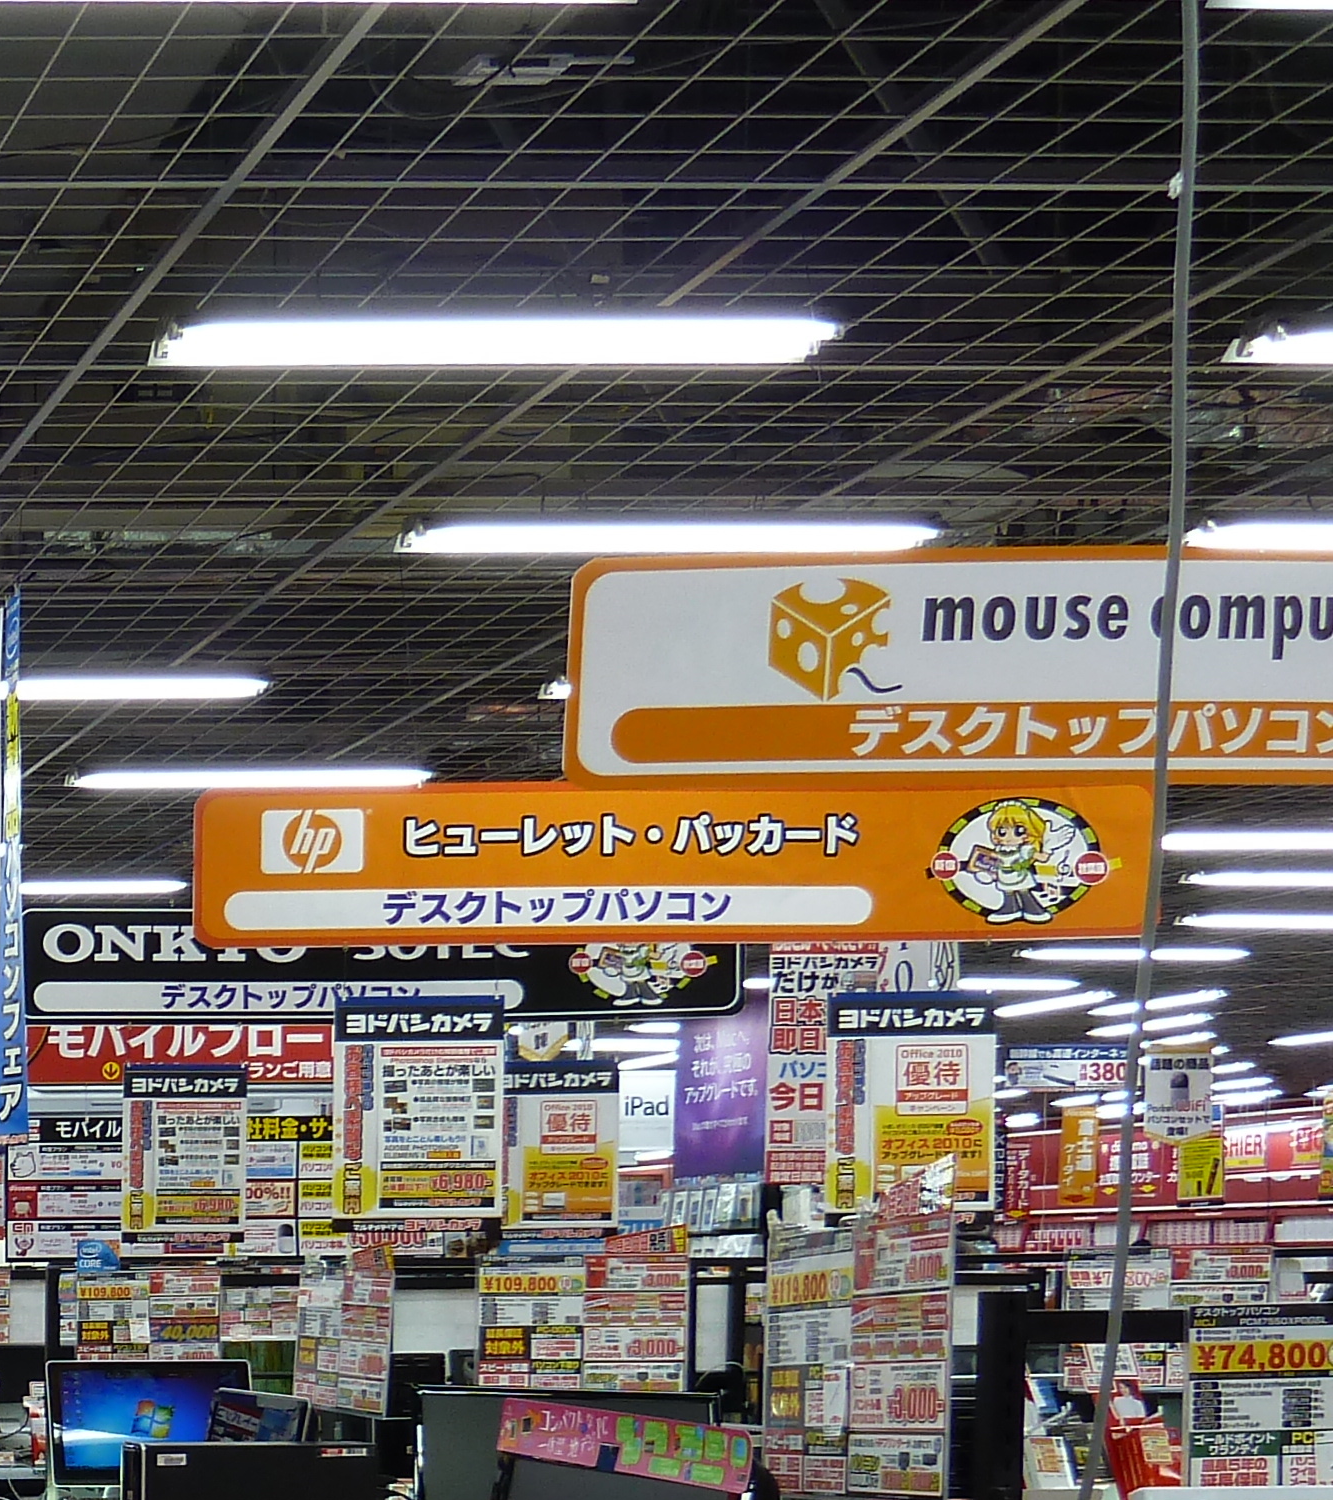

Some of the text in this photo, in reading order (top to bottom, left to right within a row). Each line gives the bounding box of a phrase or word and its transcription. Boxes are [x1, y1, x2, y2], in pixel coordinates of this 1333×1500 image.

[922, 594, 1130, 643] mouse
[289, 809, 336, 875] hp
[403, 815, 860, 859] ヒューレット・パッカード
[382, 889, 733, 928] デスクトップパソコン
[771, 954, 878, 970] ヨドバシカメラ
[772, 972, 839, 994] だけが
[345, 1012, 494, 1034] ヨドバシカメラ
[837, 1006, 986, 1028] ヨドバシカメラ
[900, 1048, 963, 1058] Office 2010
[382, 1064, 496, 1078] 撮ったあとが楽しい
[903, 1061, 961, 1086] 優待
[131, 1077, 240, 1094] ヨドバシカメラ
[624, 1095, 670, 1117] iPad
[55, 1120, 122, 1138] モバイル
[545, 1113, 592, 1133] 優待
[881, 1138, 929, 1150] オフィス
[1018, 1149, 1031, 1210] データカード
[79, 1286, 131, 1299] ¥109,800
[483, 1276, 556, 1293] ¥109,800
[771, 1272, 827, 1302] ¥119,800
[161, 1324, 218, 1341] 40,000
[484, 1340, 525, 1356] 対象外
[1197, 1342, 1327, 1373] ¥74,800
